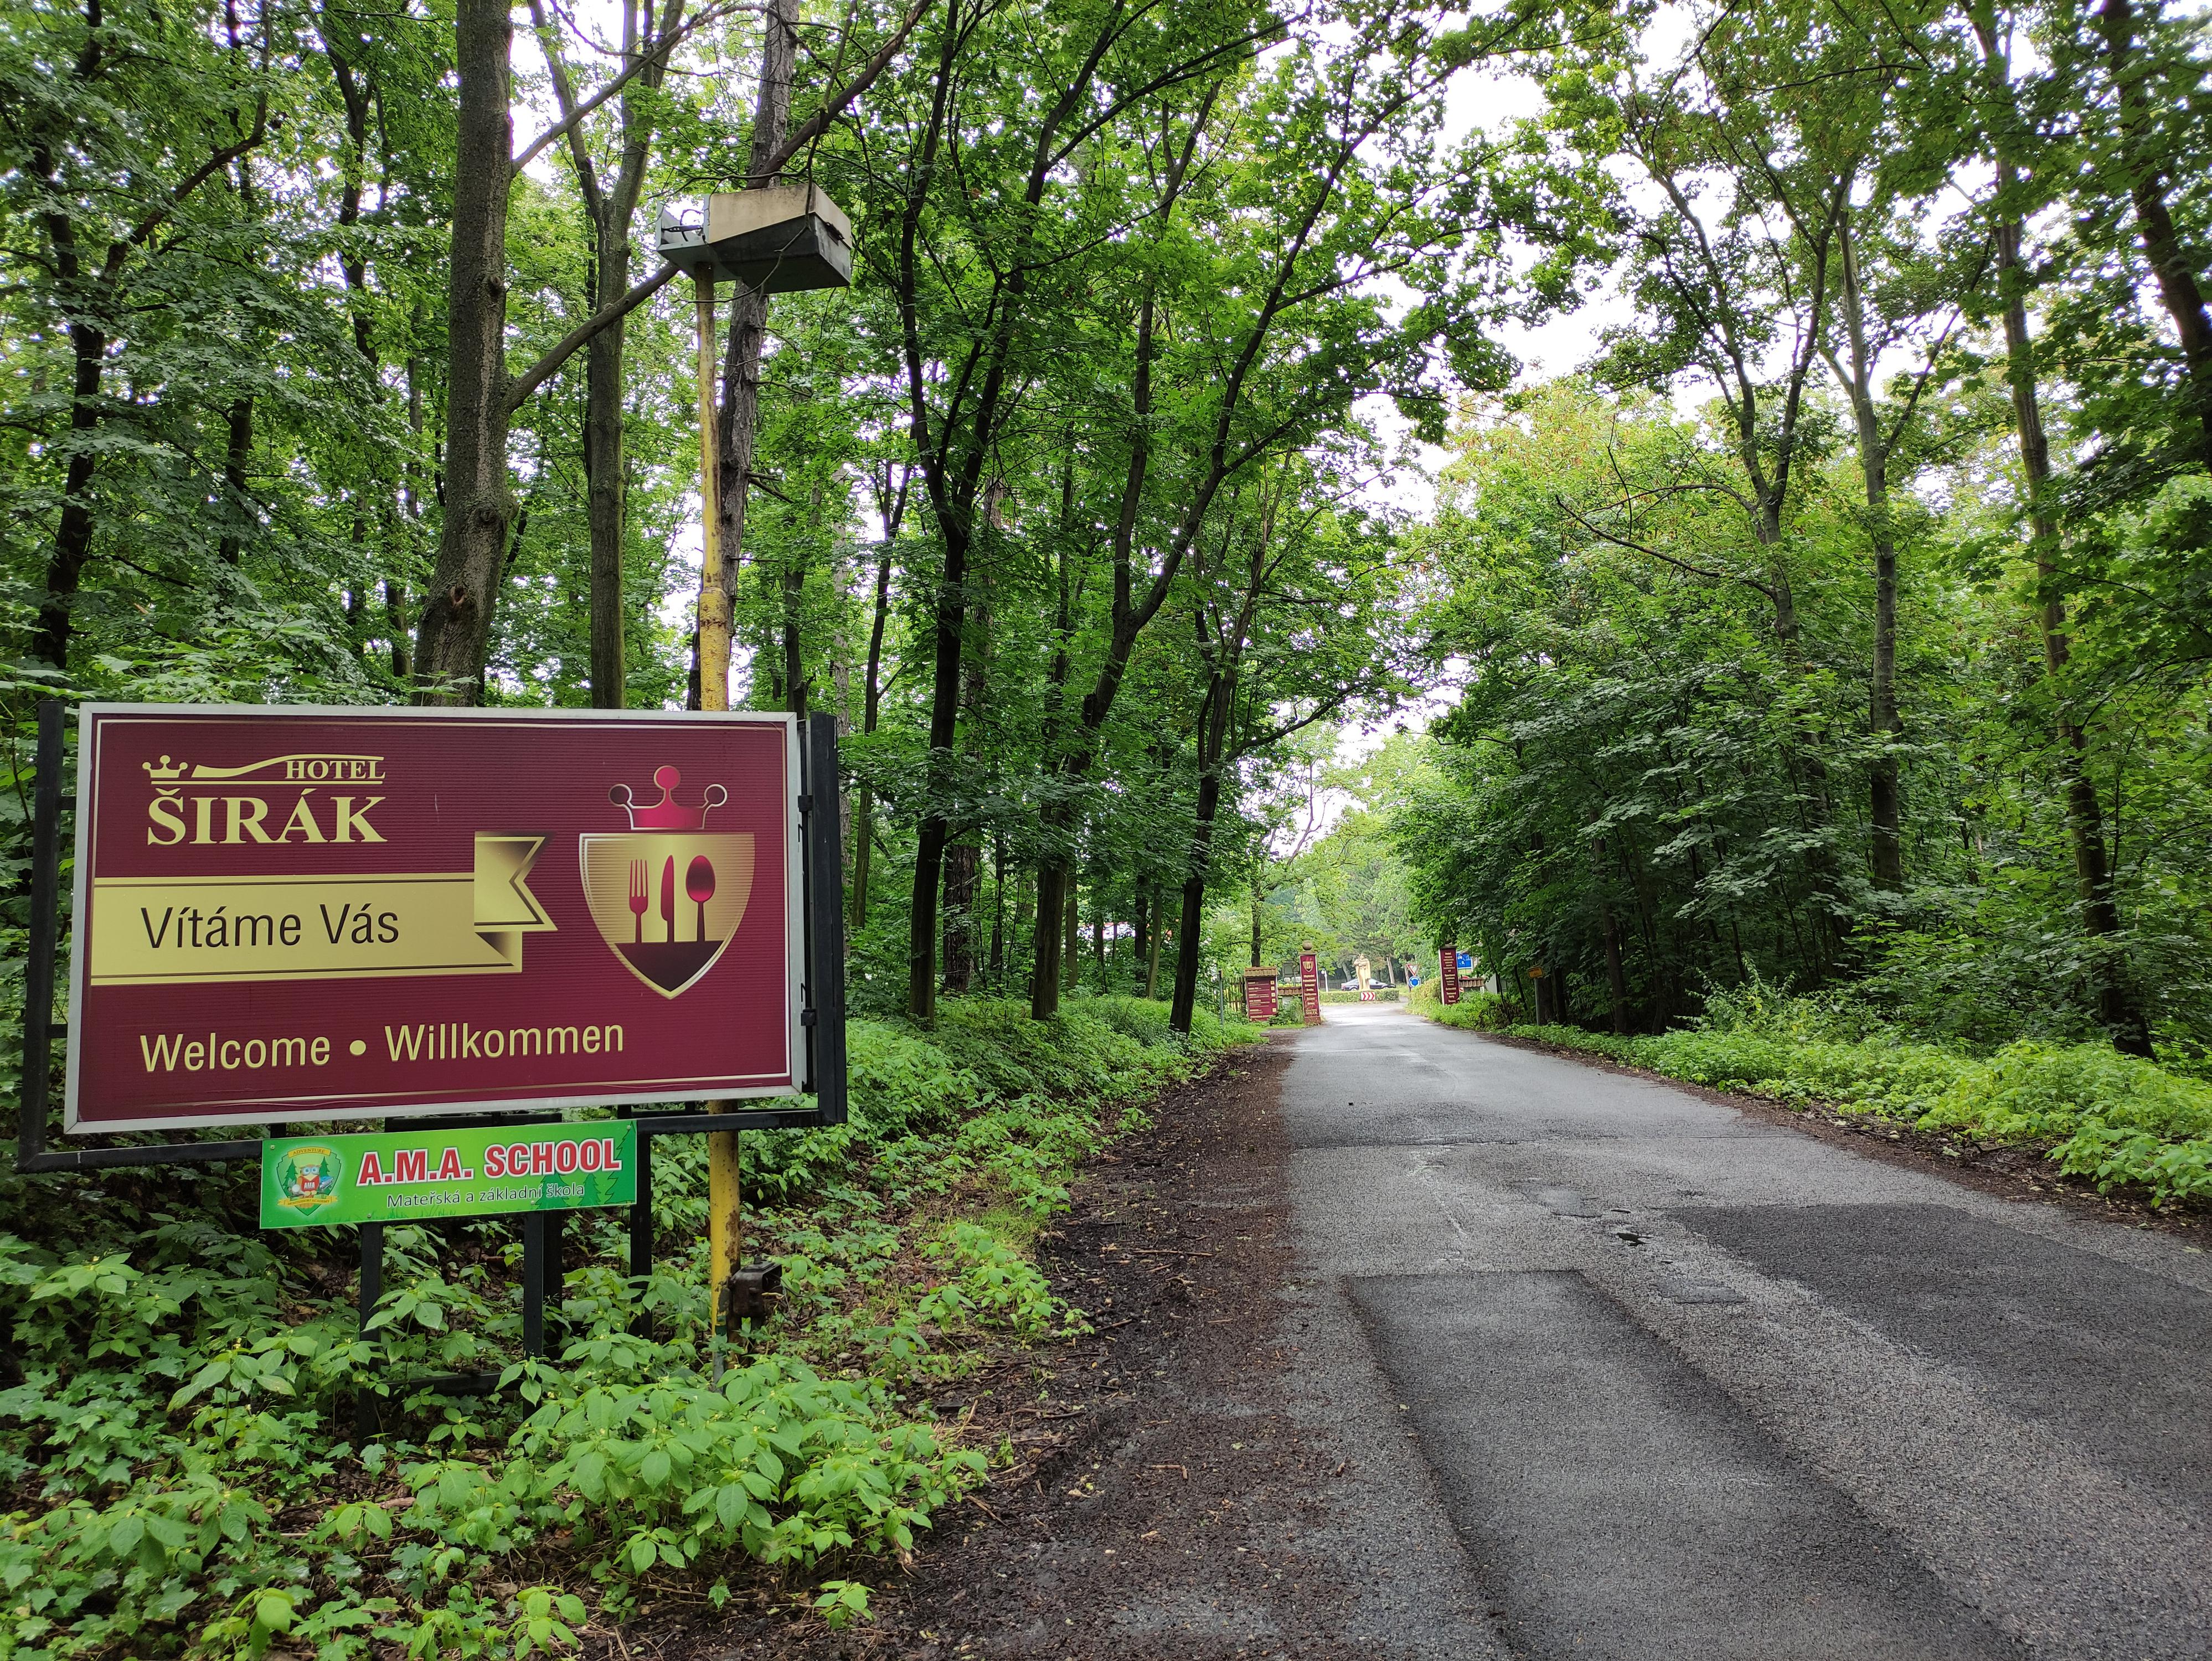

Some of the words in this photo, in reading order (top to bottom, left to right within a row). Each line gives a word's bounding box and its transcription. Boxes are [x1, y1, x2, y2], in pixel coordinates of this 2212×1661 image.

[285, 760, 386, 780] HOTEL
[147, 788, 388, 845] ŠIRÁK
[141, 906, 301, 948] Vítáme
[319, 903, 399, 944] Vás
[140, 1032, 330, 1072] Welcome
[384, 1023, 623, 1061] Willkommen
[356, 1147, 475, 1187] A.M.A.
[483, 1138, 623, 1179] SCHOOL
[387, 1189, 461, 1208] Mateřská
[466, 1191, 475, 1203] a
[479, 1183, 543, 1202] základní
[546, 1182, 585, 1197] škola
